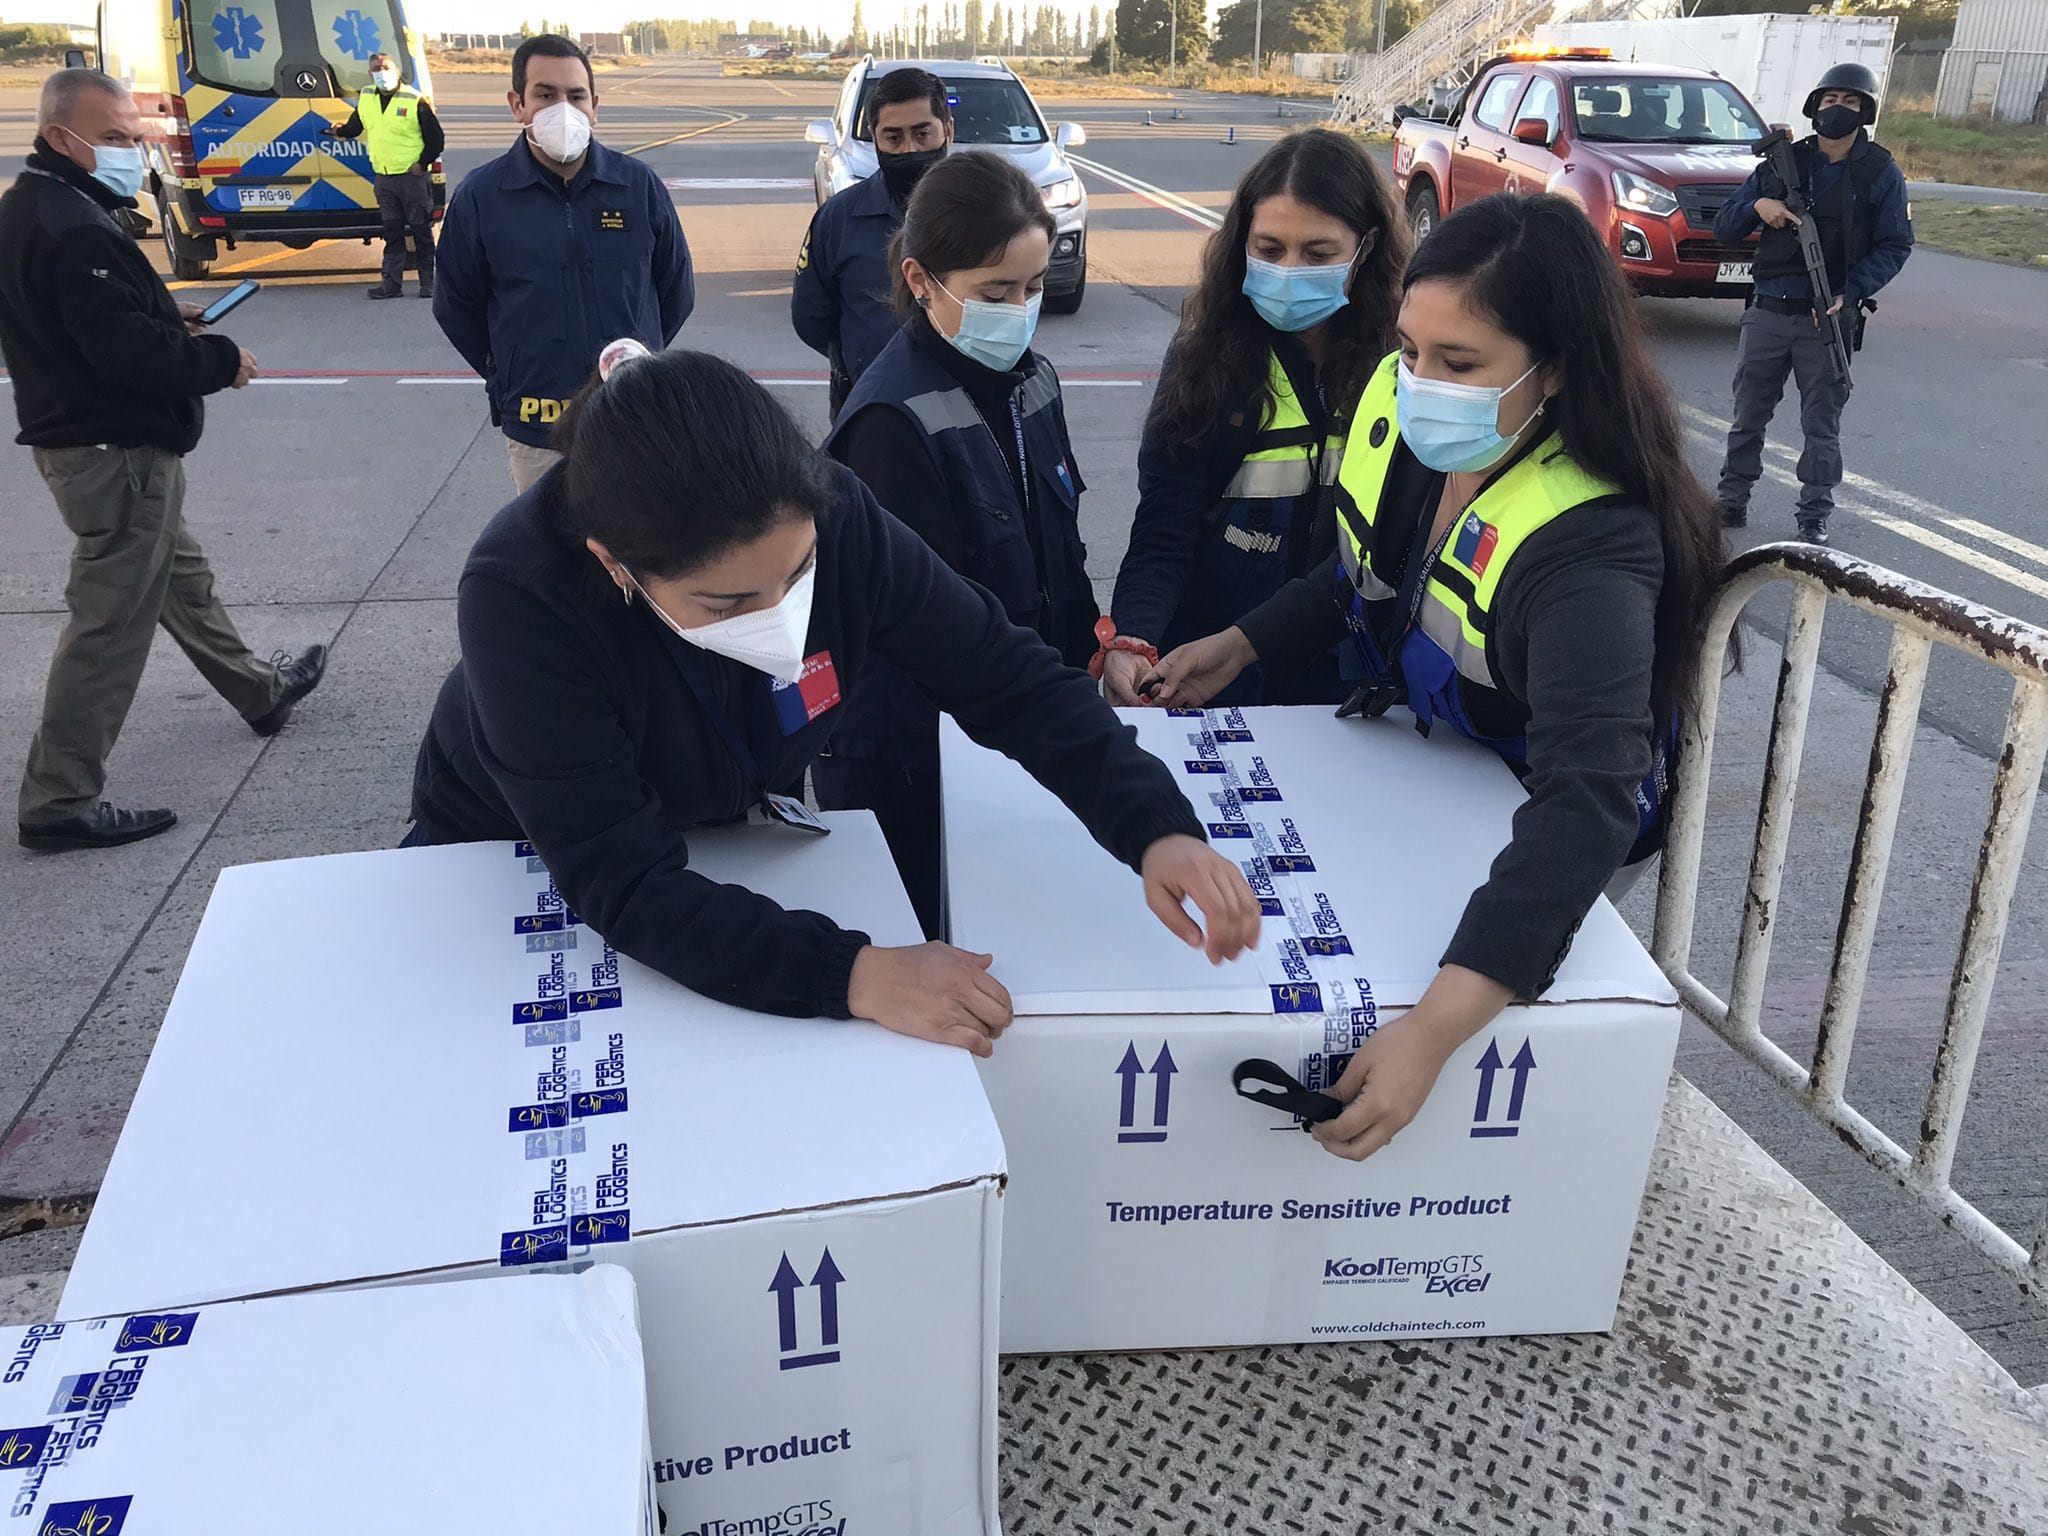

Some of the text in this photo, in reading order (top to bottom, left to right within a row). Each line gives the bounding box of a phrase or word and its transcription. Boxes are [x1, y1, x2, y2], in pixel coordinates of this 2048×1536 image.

[207, 141, 370, 158] AUTORIDAD SANIT
[240, 190, 255, 202] FF
[1420, 554, 1436, 580] SALUD
[1434, 524, 1454, 554] REGION
[1278, 834, 1292, 854] PERI
[1281, 818, 1306, 854] LOGISTICS
[1251, 857, 1275, 896] LOGISTICS
[1311, 911, 1330, 935] PERI
[1314, 892, 1342, 935] LOGISTICS
[551, 952, 565, 997] LOGISTICS
[591, 963, 605, 987] PERI
[1283, 939, 1312, 981] LOGISTICS
[538, 974, 551, 998] PERI
[1354, 978, 1377, 1037] OGISTICS
[1351, 1008, 1365, 1049] PERI
[552, 1046, 567, 1100] LOGISTICS
[595, 1059, 610, 1087] PERI
[609, 1033, 625, 1086] LOGISTICS
[1308, 1052, 1322, 1091] STICS
[537, 1072, 552, 1101] PERI
[550, 1158, 567, 1223] LOGISTICS
[596, 1174, 612, 1209] PERI
[612, 1142, 628, 1207] LOGISTICS
[533, 1190, 550, 1225] PERI
[1106, 1194, 1511, 1225] Temperature Sensitive Product
[1425, 1273, 1491, 1297] Excel
[1311, 1320, 1486, 1334] www.coldchaintech.com
[3, 1324, 48, 1383] GISTICS
[114, 1355, 149, 1402] PERI
[76, 1357, 129, 1449] LOGISTICS
[724, 1428, 851, 1471] Product
